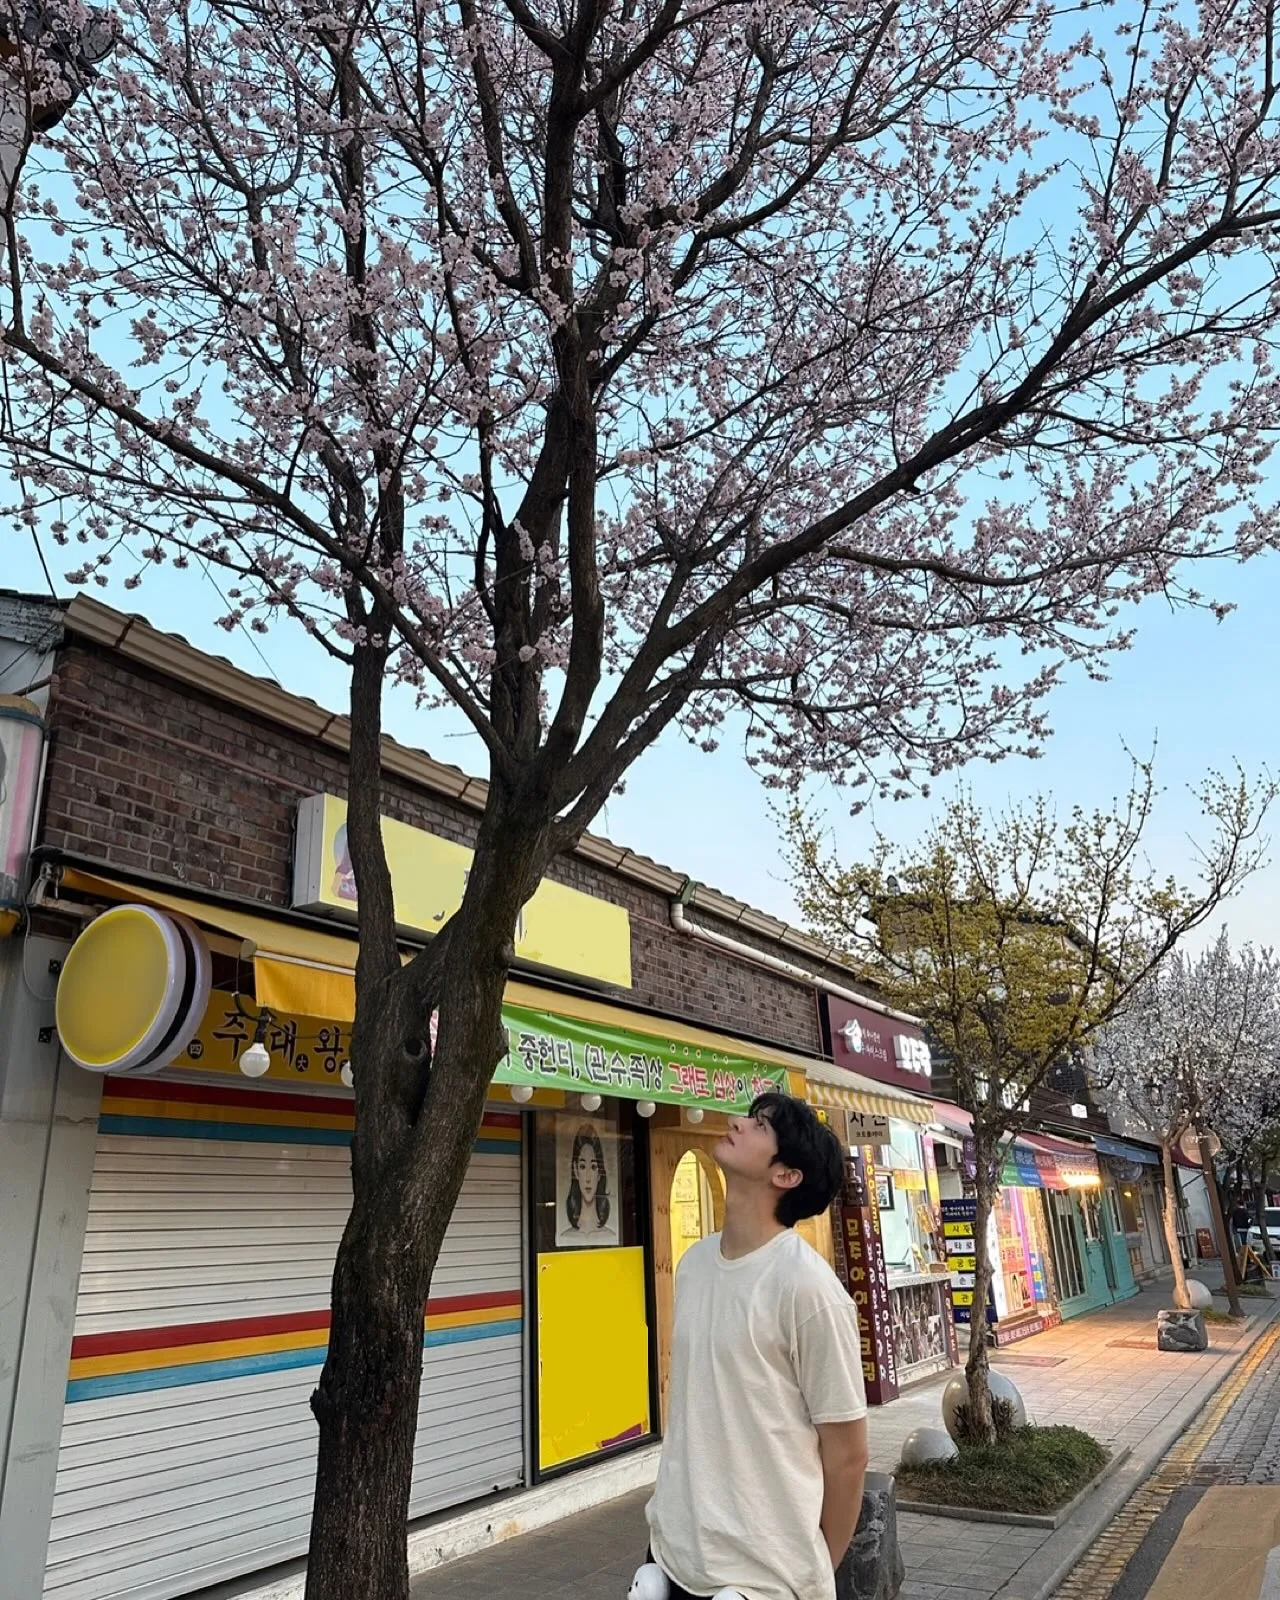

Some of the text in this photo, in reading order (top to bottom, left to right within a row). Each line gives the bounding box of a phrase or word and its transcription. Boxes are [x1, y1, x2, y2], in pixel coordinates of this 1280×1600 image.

[518, 1034, 579, 1079] 중헌디,
[668, 1062, 712, 1097] 그래도
[713, 1069, 752, 1104] 심상이
